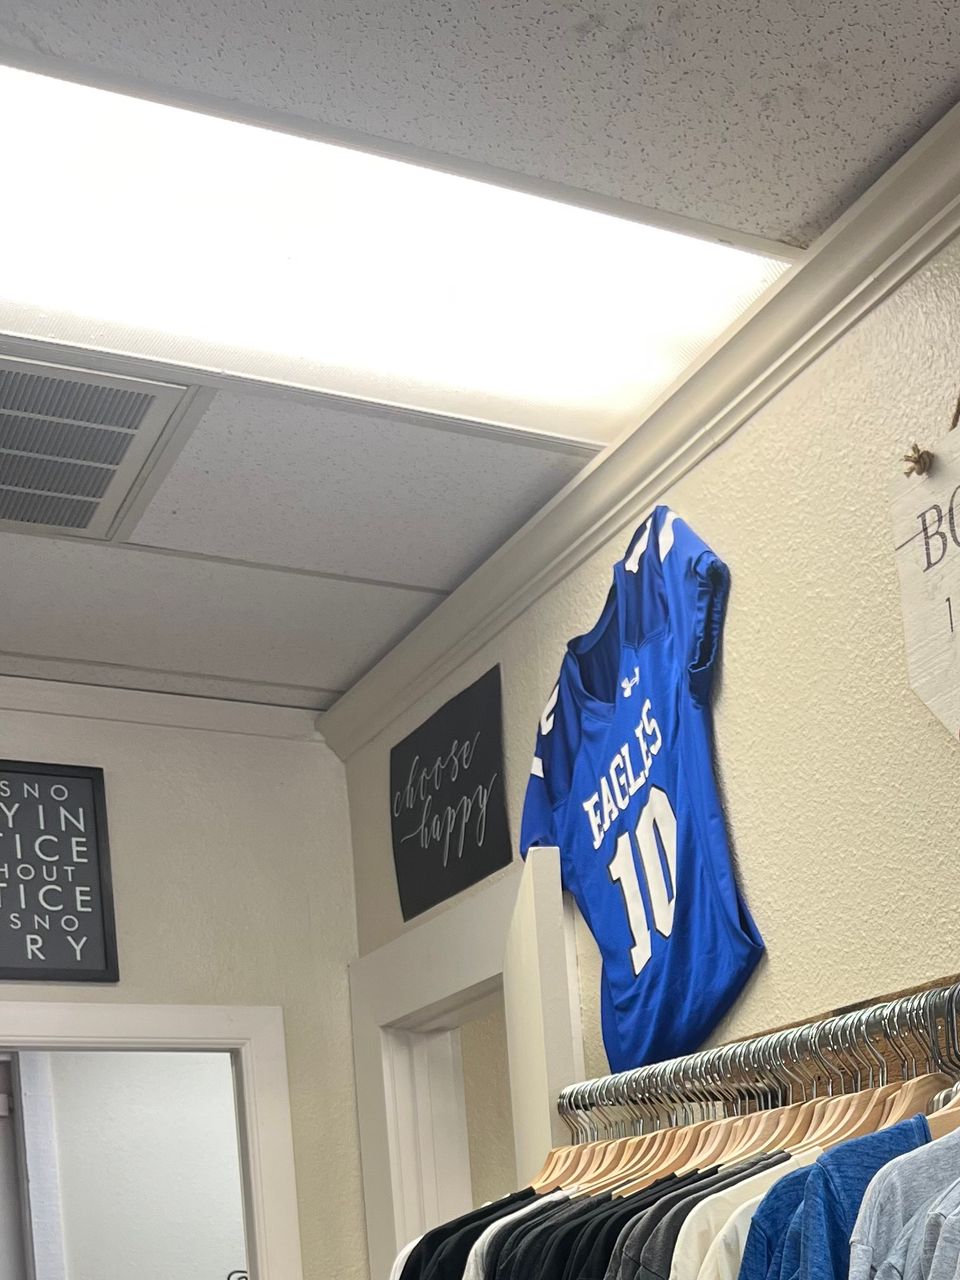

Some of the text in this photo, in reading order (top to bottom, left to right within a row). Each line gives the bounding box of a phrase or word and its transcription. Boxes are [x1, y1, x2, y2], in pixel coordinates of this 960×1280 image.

[393, 731, 481, 818] choose
[0, 833, 89, 863] ICE
[400, 773, 498, 868] happy
[608, 785, 678, 977] 10
